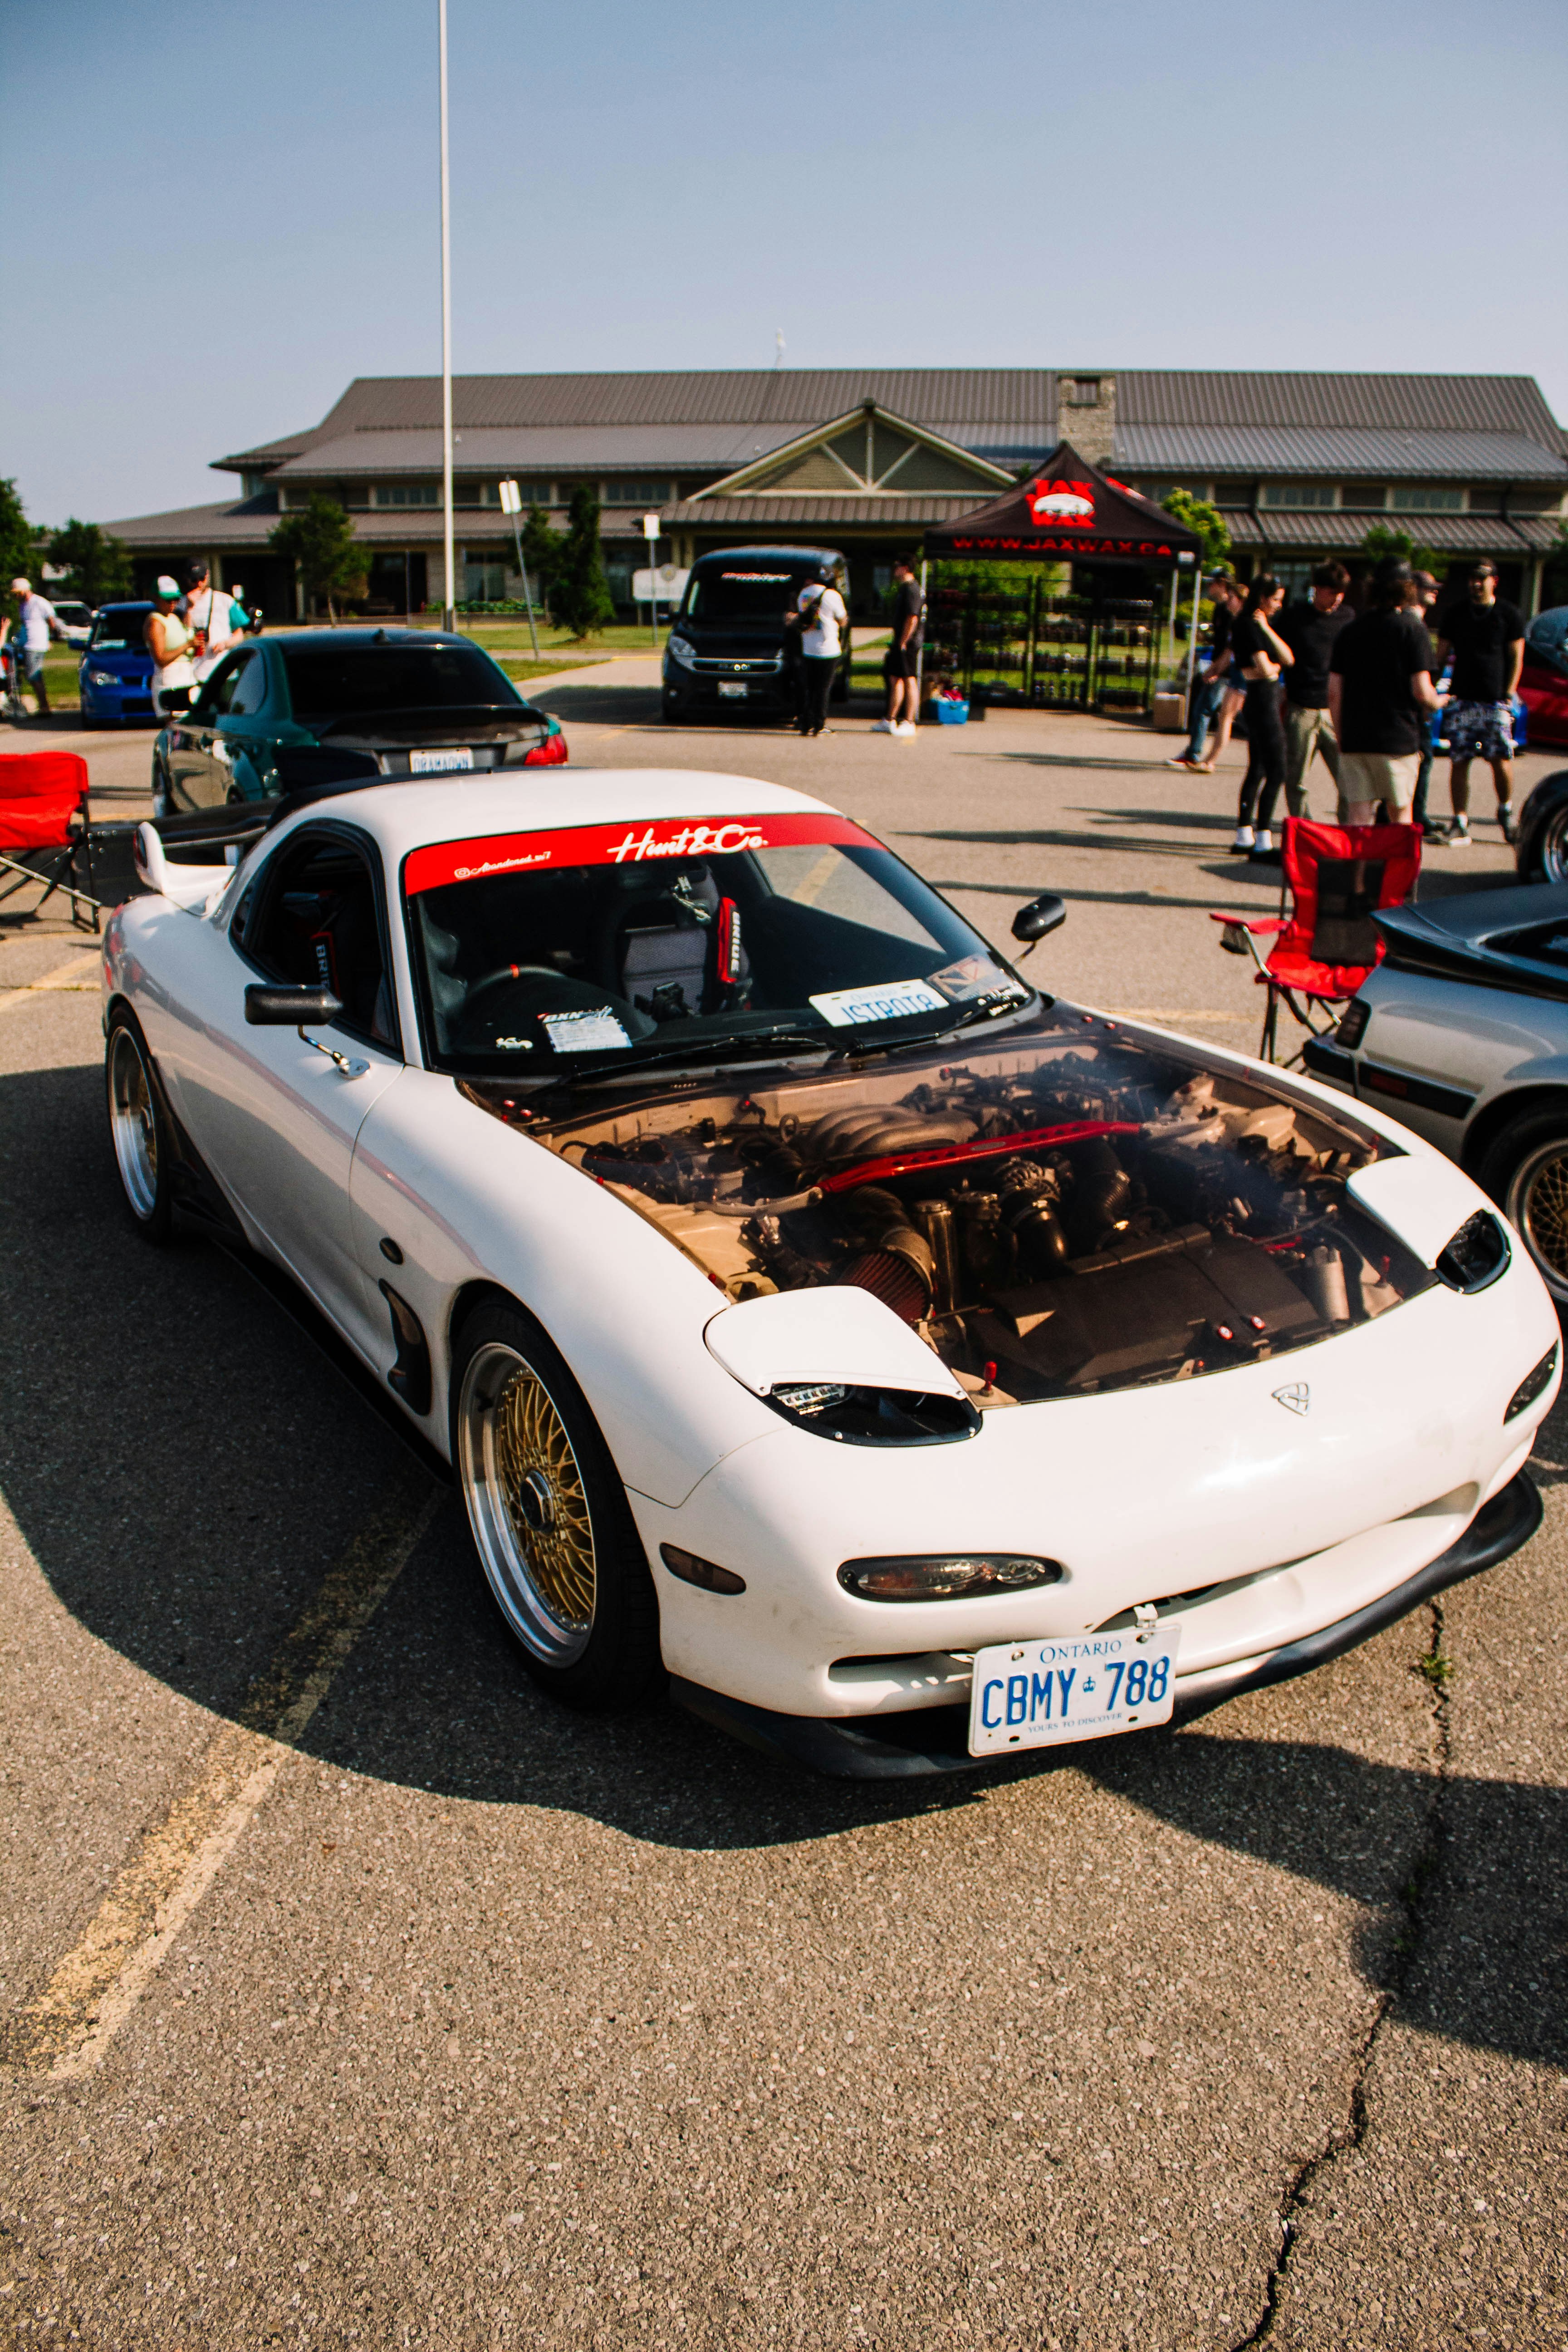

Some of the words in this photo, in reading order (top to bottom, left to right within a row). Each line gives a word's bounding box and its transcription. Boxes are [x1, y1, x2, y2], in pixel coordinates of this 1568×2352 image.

[1040, 1640, 1122, 1664] ONTARIO
[982, 1667, 1077, 1729] CBMY
[1105, 1656, 1171, 1711] 788
[1028, 1722, 1059, 1733] YOURS
[1062, 1720, 1075, 1728] TO
[1078, 1713, 1122, 1726] DISCOVER
